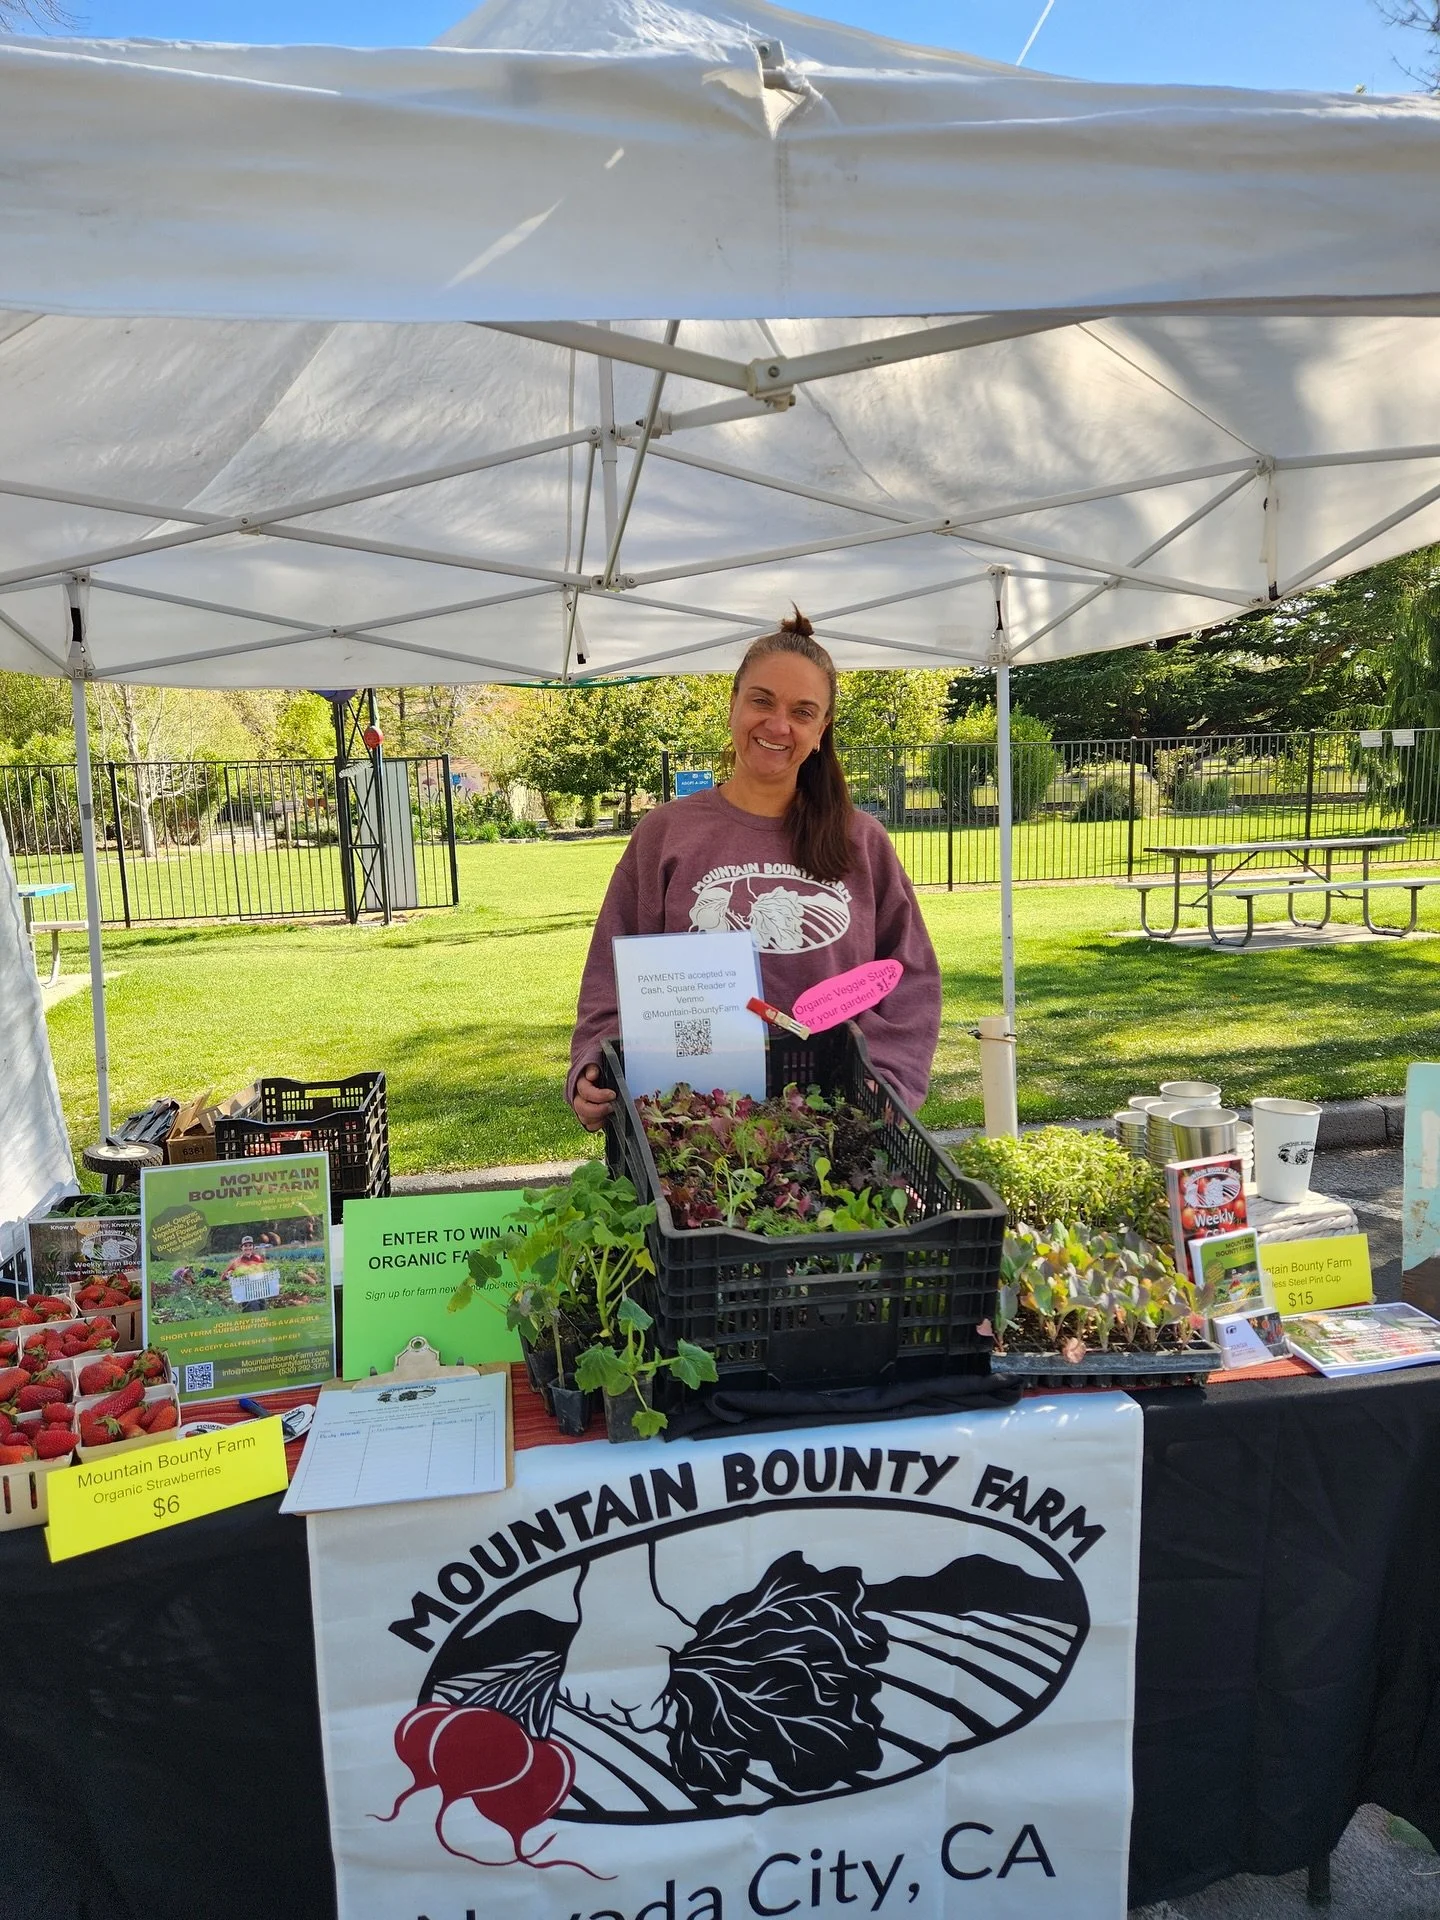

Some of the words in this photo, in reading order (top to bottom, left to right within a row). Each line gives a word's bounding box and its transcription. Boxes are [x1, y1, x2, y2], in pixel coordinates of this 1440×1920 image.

[692, 863, 759, 894] MOUNTAIN
[638, 972, 686, 983] PAYMENTS
[688, 970, 723, 980] accepted
[725, 970, 736, 978] via
[641, 987, 664, 995] Cash,
[667, 984, 695, 994] Square
[697, 982, 726, 991] Reader
[795, 992, 833, 1015] Organic
[833, 978, 867, 997] Veggie
[867, 965, 896, 982] Starts
[676, 995, 704, 1004] Venmo
[817, 1007, 838, 1025] your
[840, 988, 876, 1013] garden!
[643, 1003, 740, 1021] @Mountain-BountyFarm
[220, 1167, 319, 1187] MOUNTAIN
[189, 1183, 266, 1202] BOUNTY
[268, 1179, 320, 1194] FARM
[1194, 1208, 1235, 1227] Weekly
[164, 1233, 176, 1243] and
[383, 1230, 438, 1247] ENTER
[443, 1228, 465, 1242] TO
[470, 1226, 500, 1240] WIN
[368, 1251, 447, 1270] ORGANIC
[1291, 1261, 1324, 1273] Bounty
[1327, 1258, 1352, 1269] Farm
[1289, 1278, 1308, 1287] Steel
[1309, 1275, 1324, 1284] Pint
[1325, 1274, 1342, 1284] Cup
[365, 1291, 387, 1302] Sign
[388, 1291, 400, 1301] up
[402, 1288, 414, 1298] for
[416, 1286, 437, 1297] farm
[1288, 1291, 1314, 1308] $15
[213, 1321, 233, 1329] JOIN
[160, 1332, 188, 1342] SHORT
[189, 1329, 212, 1338] TERM
[193, 1343, 223, 1353] ACCEPT
[222, 1356, 327, 1377] info@mountainbountyfarm.com
[241, 1349, 330, 1368] MountainBountyFarm.com
[278, 1366, 297, 1377] (530)
[78, 1460, 153, 1488] Mountain
[158, 1447, 212, 1470] Bounty
[217, 1435, 256, 1455] Farm
[94, 1485, 143, 1504] Organic
[146, 1464, 222, 1491] Strawberries
[153, 1494, 181, 1518] $6
[387, 1461, 699, 1653] MOUNTAIN
[722, 1446, 959, 1504] BOUNTY
[970, 1464, 1107, 1563] FARM
[747, 1847, 921, 1917] City,
[940, 1821, 1056, 1882] CA
